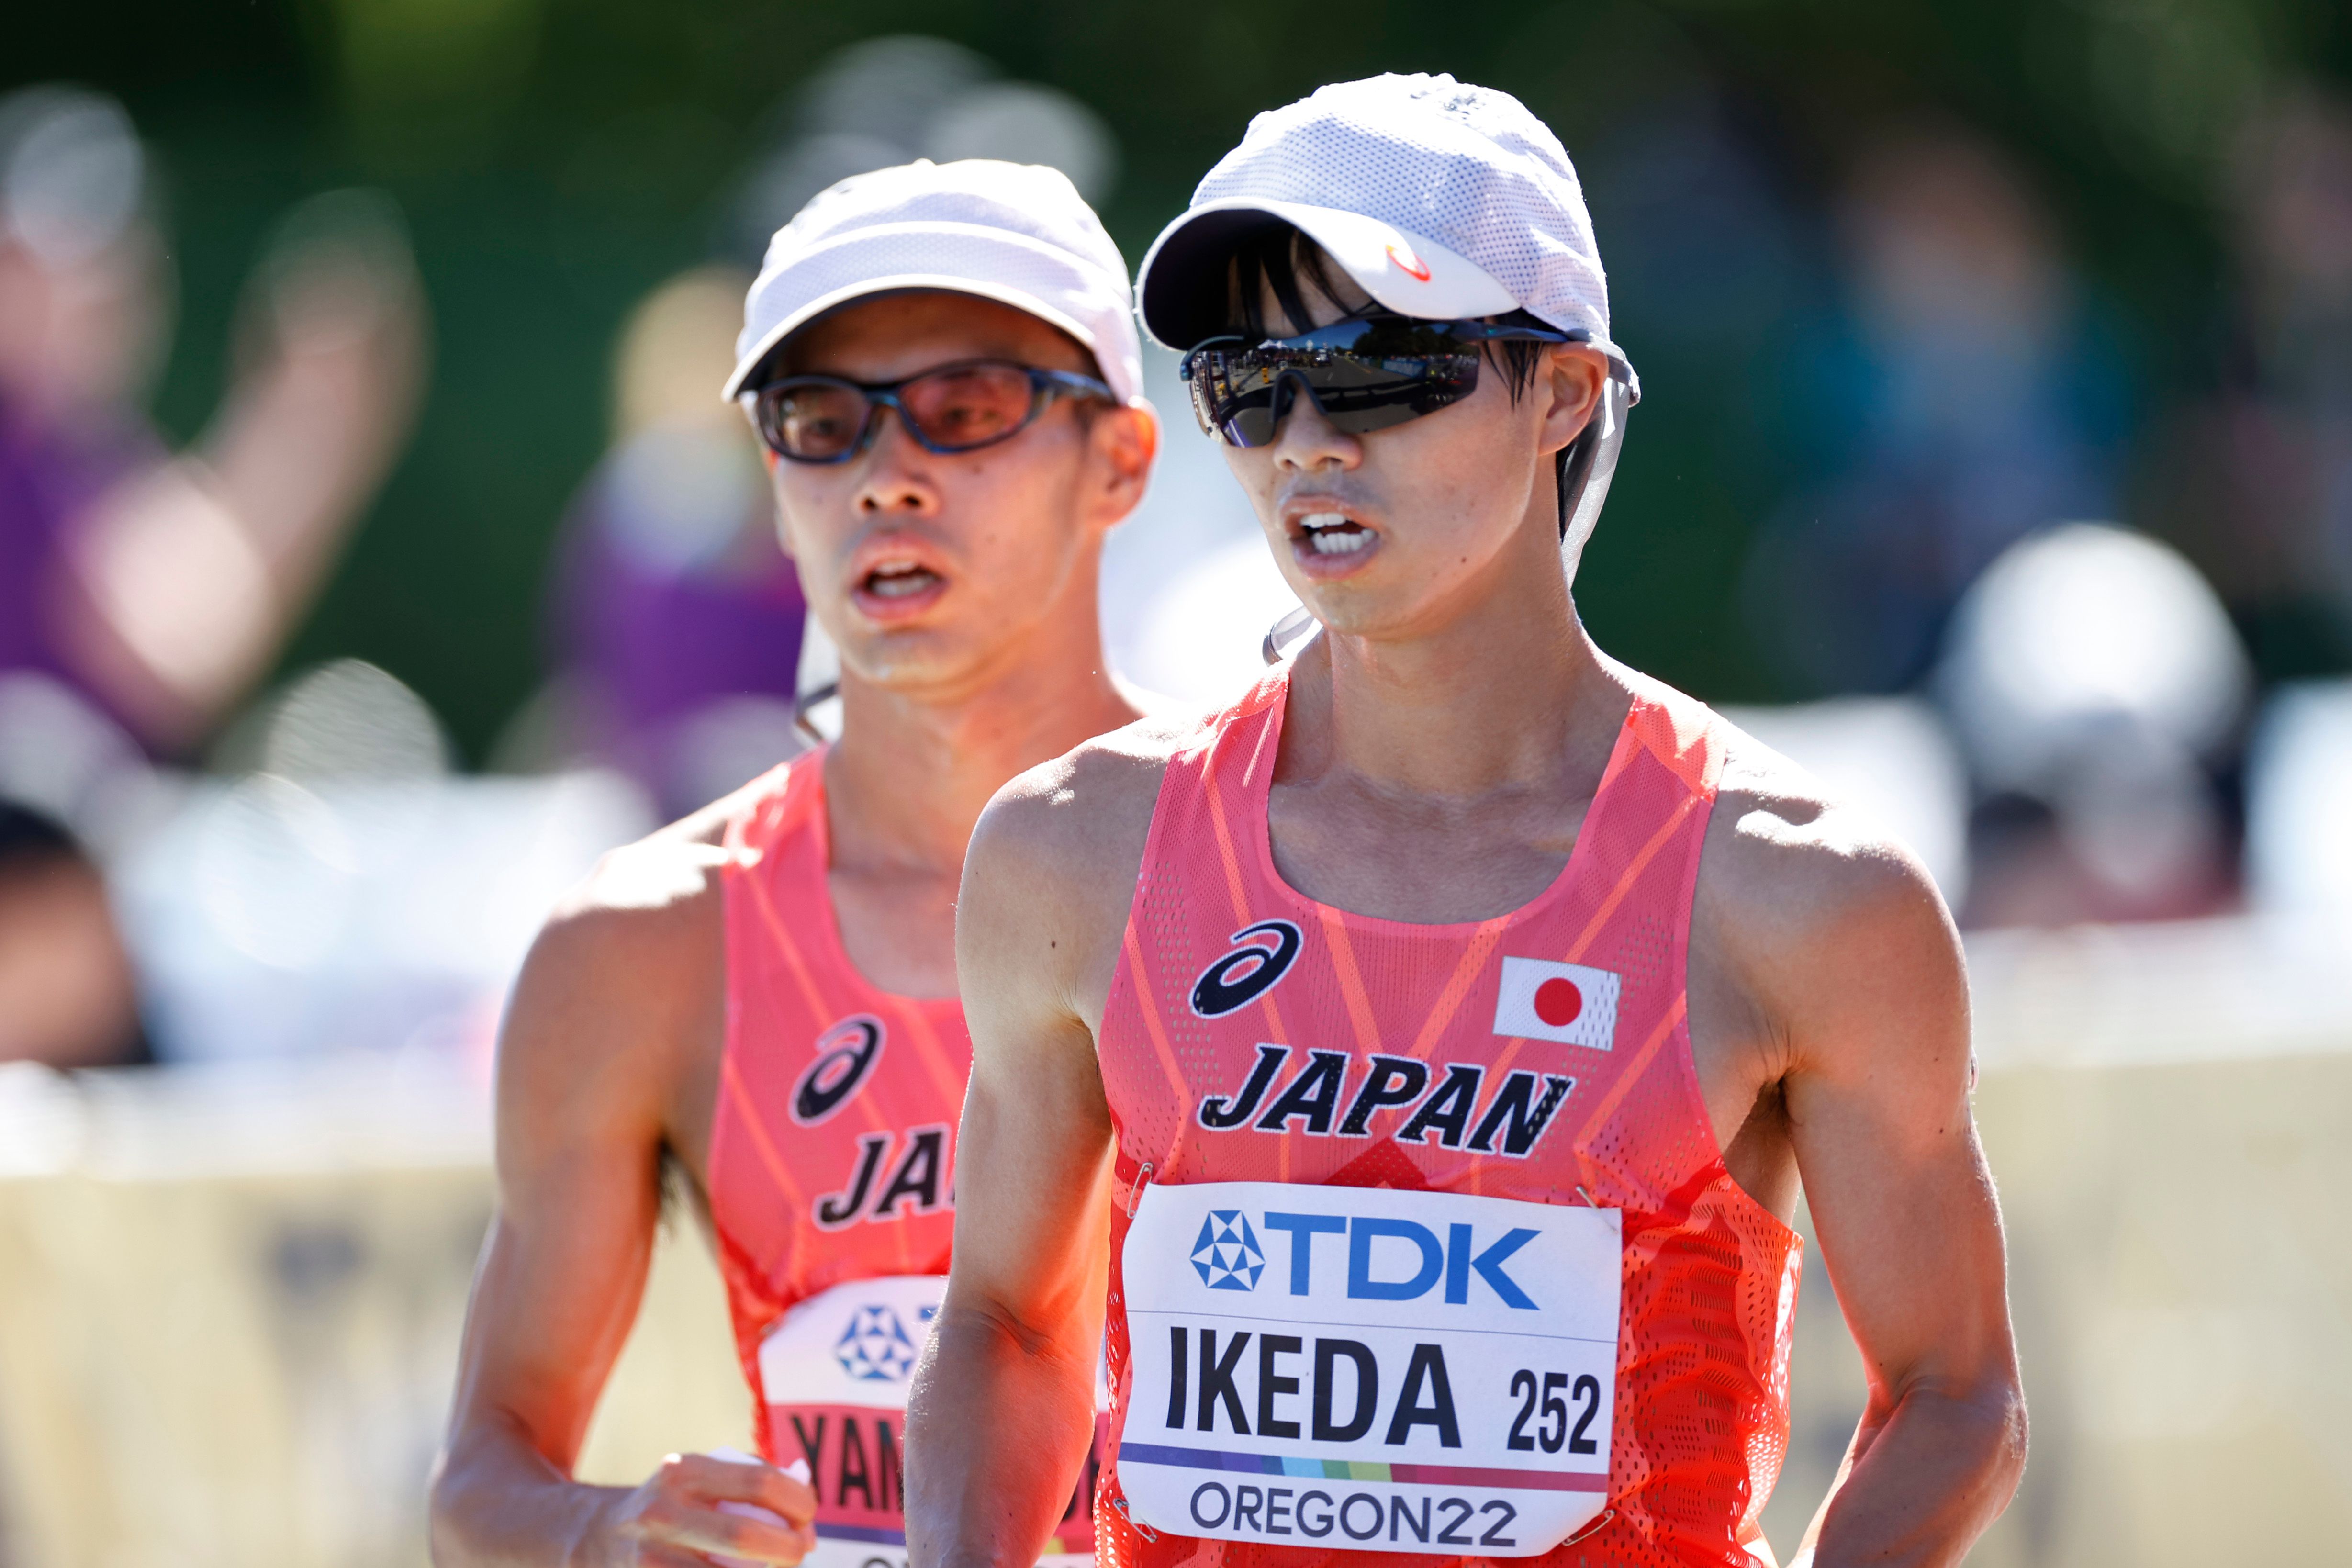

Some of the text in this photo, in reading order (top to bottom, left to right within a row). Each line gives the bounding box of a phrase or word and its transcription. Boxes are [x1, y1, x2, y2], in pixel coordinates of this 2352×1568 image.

[1198, 1044, 1575, 1157] JAPAN
[1264, 1211, 1542, 1311] TDK
[1165, 1326, 1601, 1455] IKEDA 252
[1189, 1481, 1518, 1548] OREGON22
